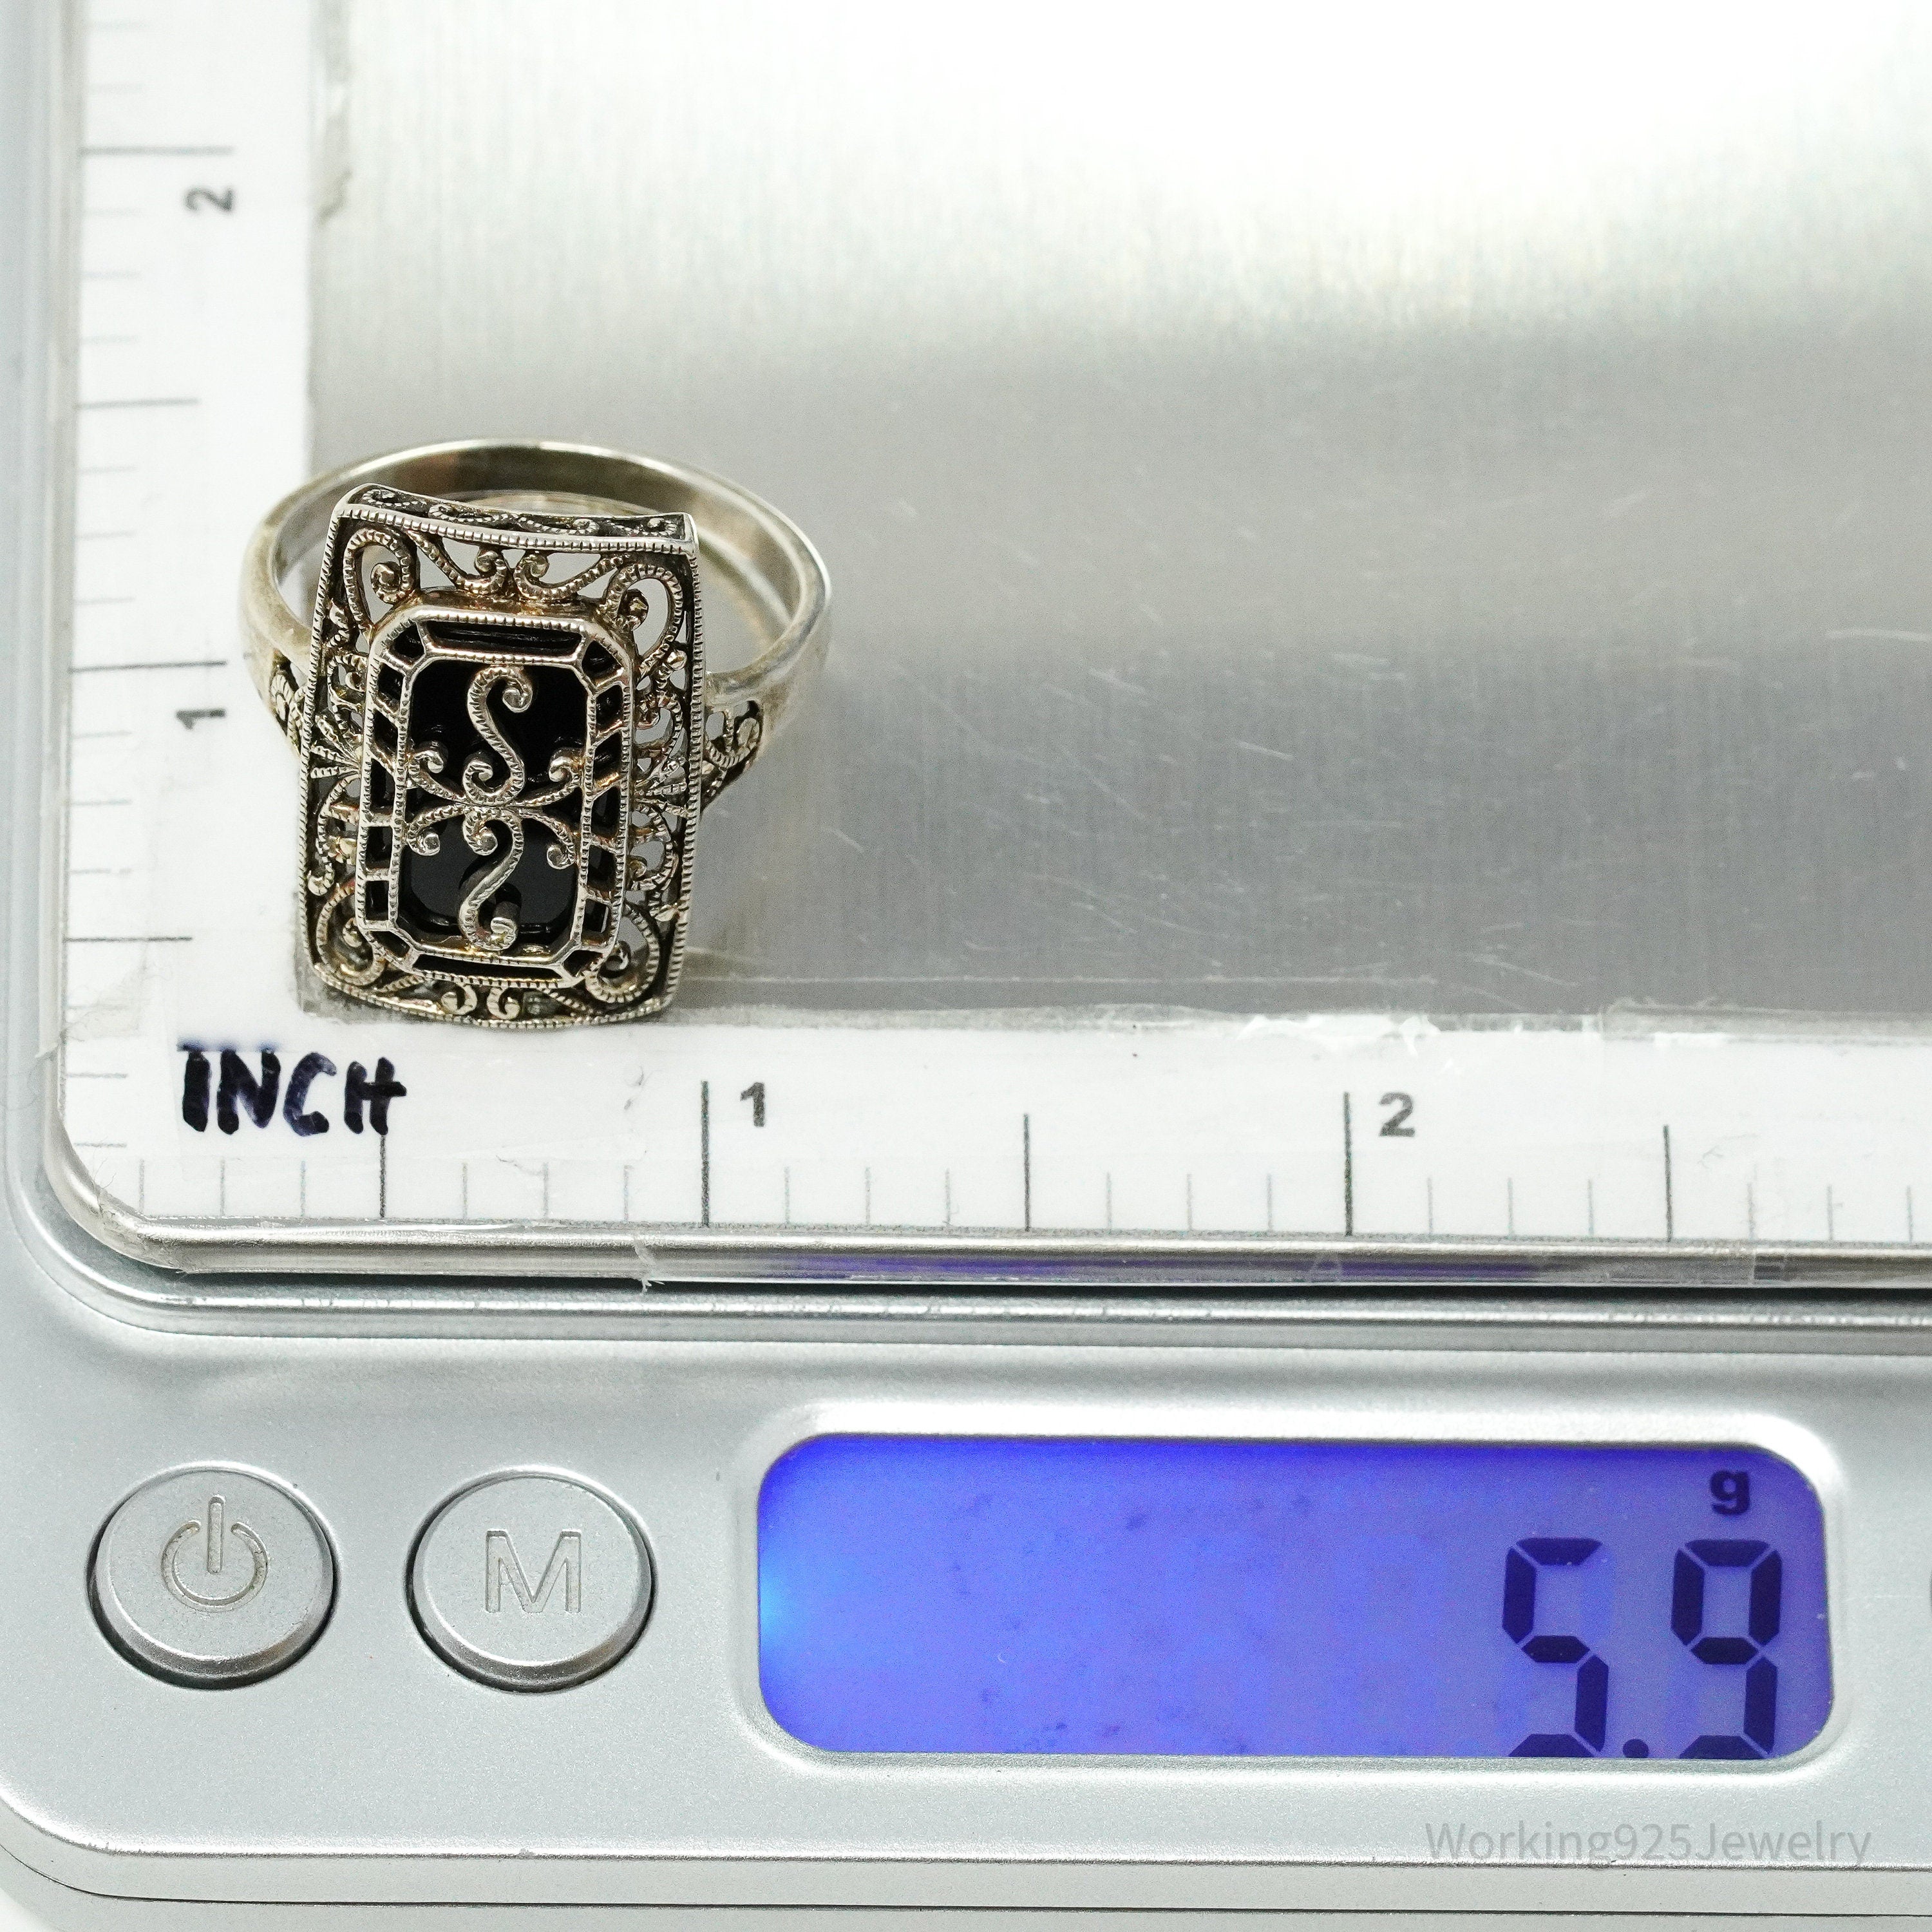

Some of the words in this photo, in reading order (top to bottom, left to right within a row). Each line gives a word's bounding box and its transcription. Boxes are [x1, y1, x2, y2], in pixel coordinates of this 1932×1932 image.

[184, 185, 234, 214] 2
[175, 708, 226, 730] 1
[176, 1037, 407, 1137] INCH
[740, 1081, 765, 1127] 1
[1379, 1092, 1416, 1137] 2
[1710, 1470, 1750, 1515] g
[485, 1528, 581, 1613] M
[1502, 1537, 1782, 1759] 5.9
